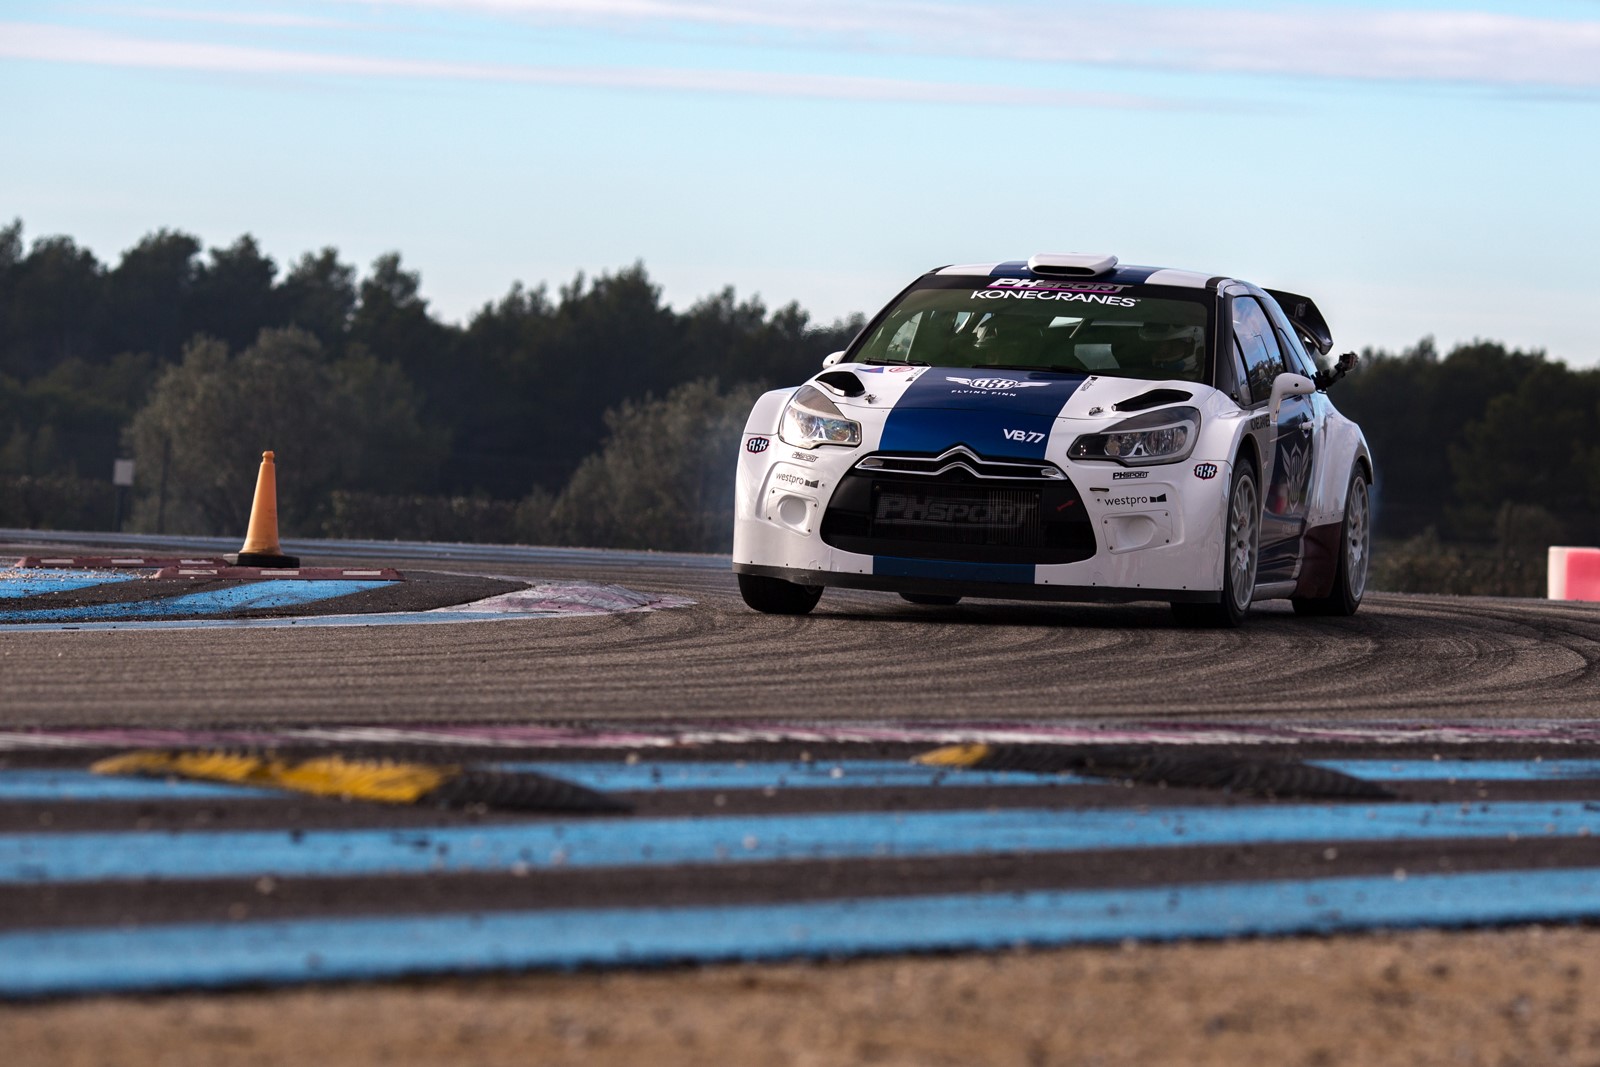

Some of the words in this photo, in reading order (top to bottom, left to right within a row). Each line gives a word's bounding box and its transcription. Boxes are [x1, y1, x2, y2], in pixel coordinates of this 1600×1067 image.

[970, 290, 1136, 307] KONECRANES
[776, 471, 804, 485] westpro
[1112, 471, 1149, 480] PHSPORT
[1104, 495, 1147, 507] westpro
